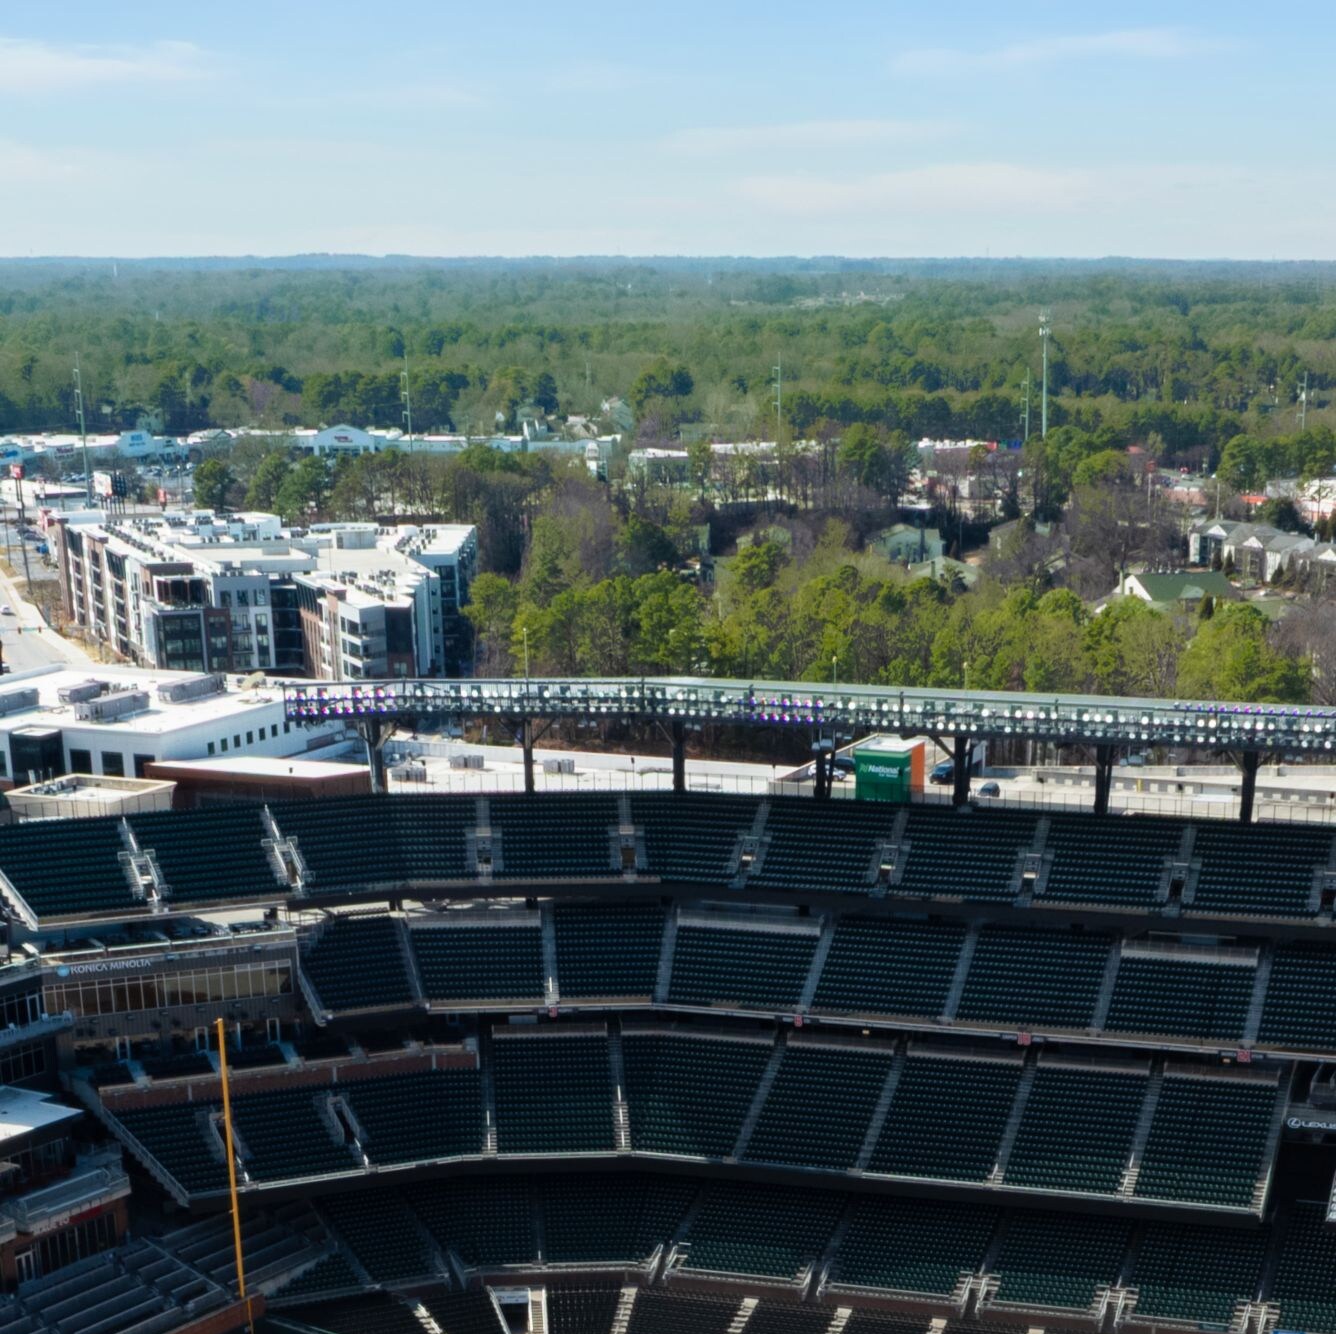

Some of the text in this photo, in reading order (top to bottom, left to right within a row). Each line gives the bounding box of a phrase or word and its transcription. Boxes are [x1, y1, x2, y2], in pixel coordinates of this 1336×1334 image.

[868, 764, 901, 775] National
[71, 958, 152, 975] KONICA MINOLTA
